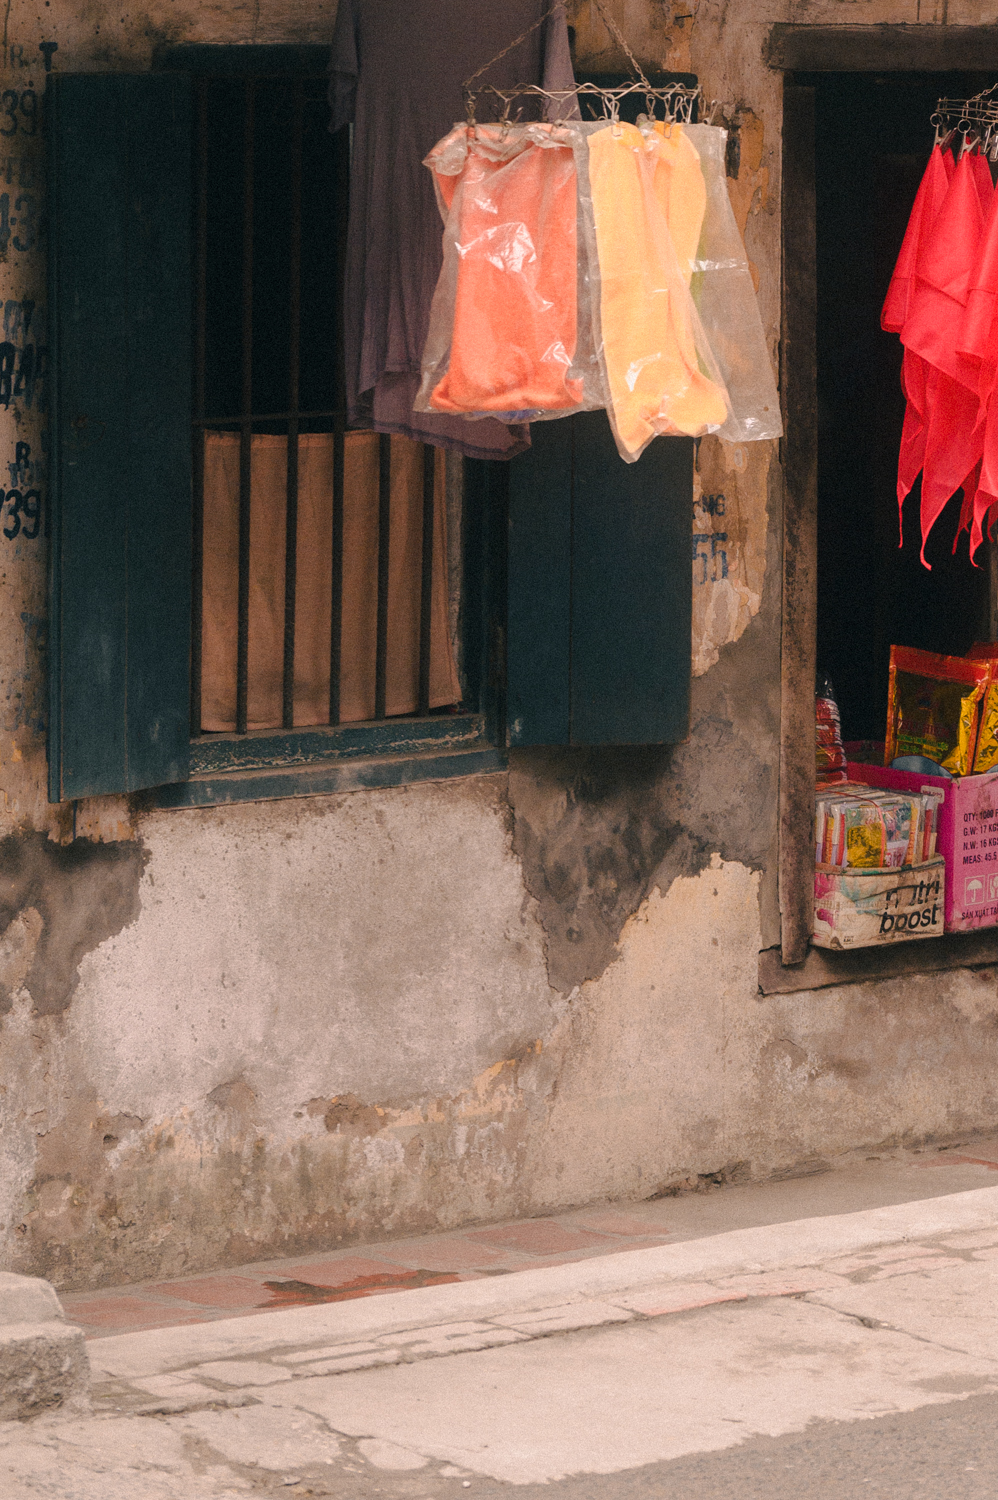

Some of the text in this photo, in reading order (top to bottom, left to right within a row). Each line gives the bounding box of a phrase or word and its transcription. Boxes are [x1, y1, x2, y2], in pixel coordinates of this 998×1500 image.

[964, 812, 978, 822] QTY:
[964, 827, 978, 836] G.W:
[980, 825, 987, 833] 17
[963, 841, 978, 850] N.W:
[981, 839, 987, 847] 16
[963, 854, 983, 864] MEAS:
[985, 852, 997, 861] 45.5
[879, 904, 939, 933] boost
